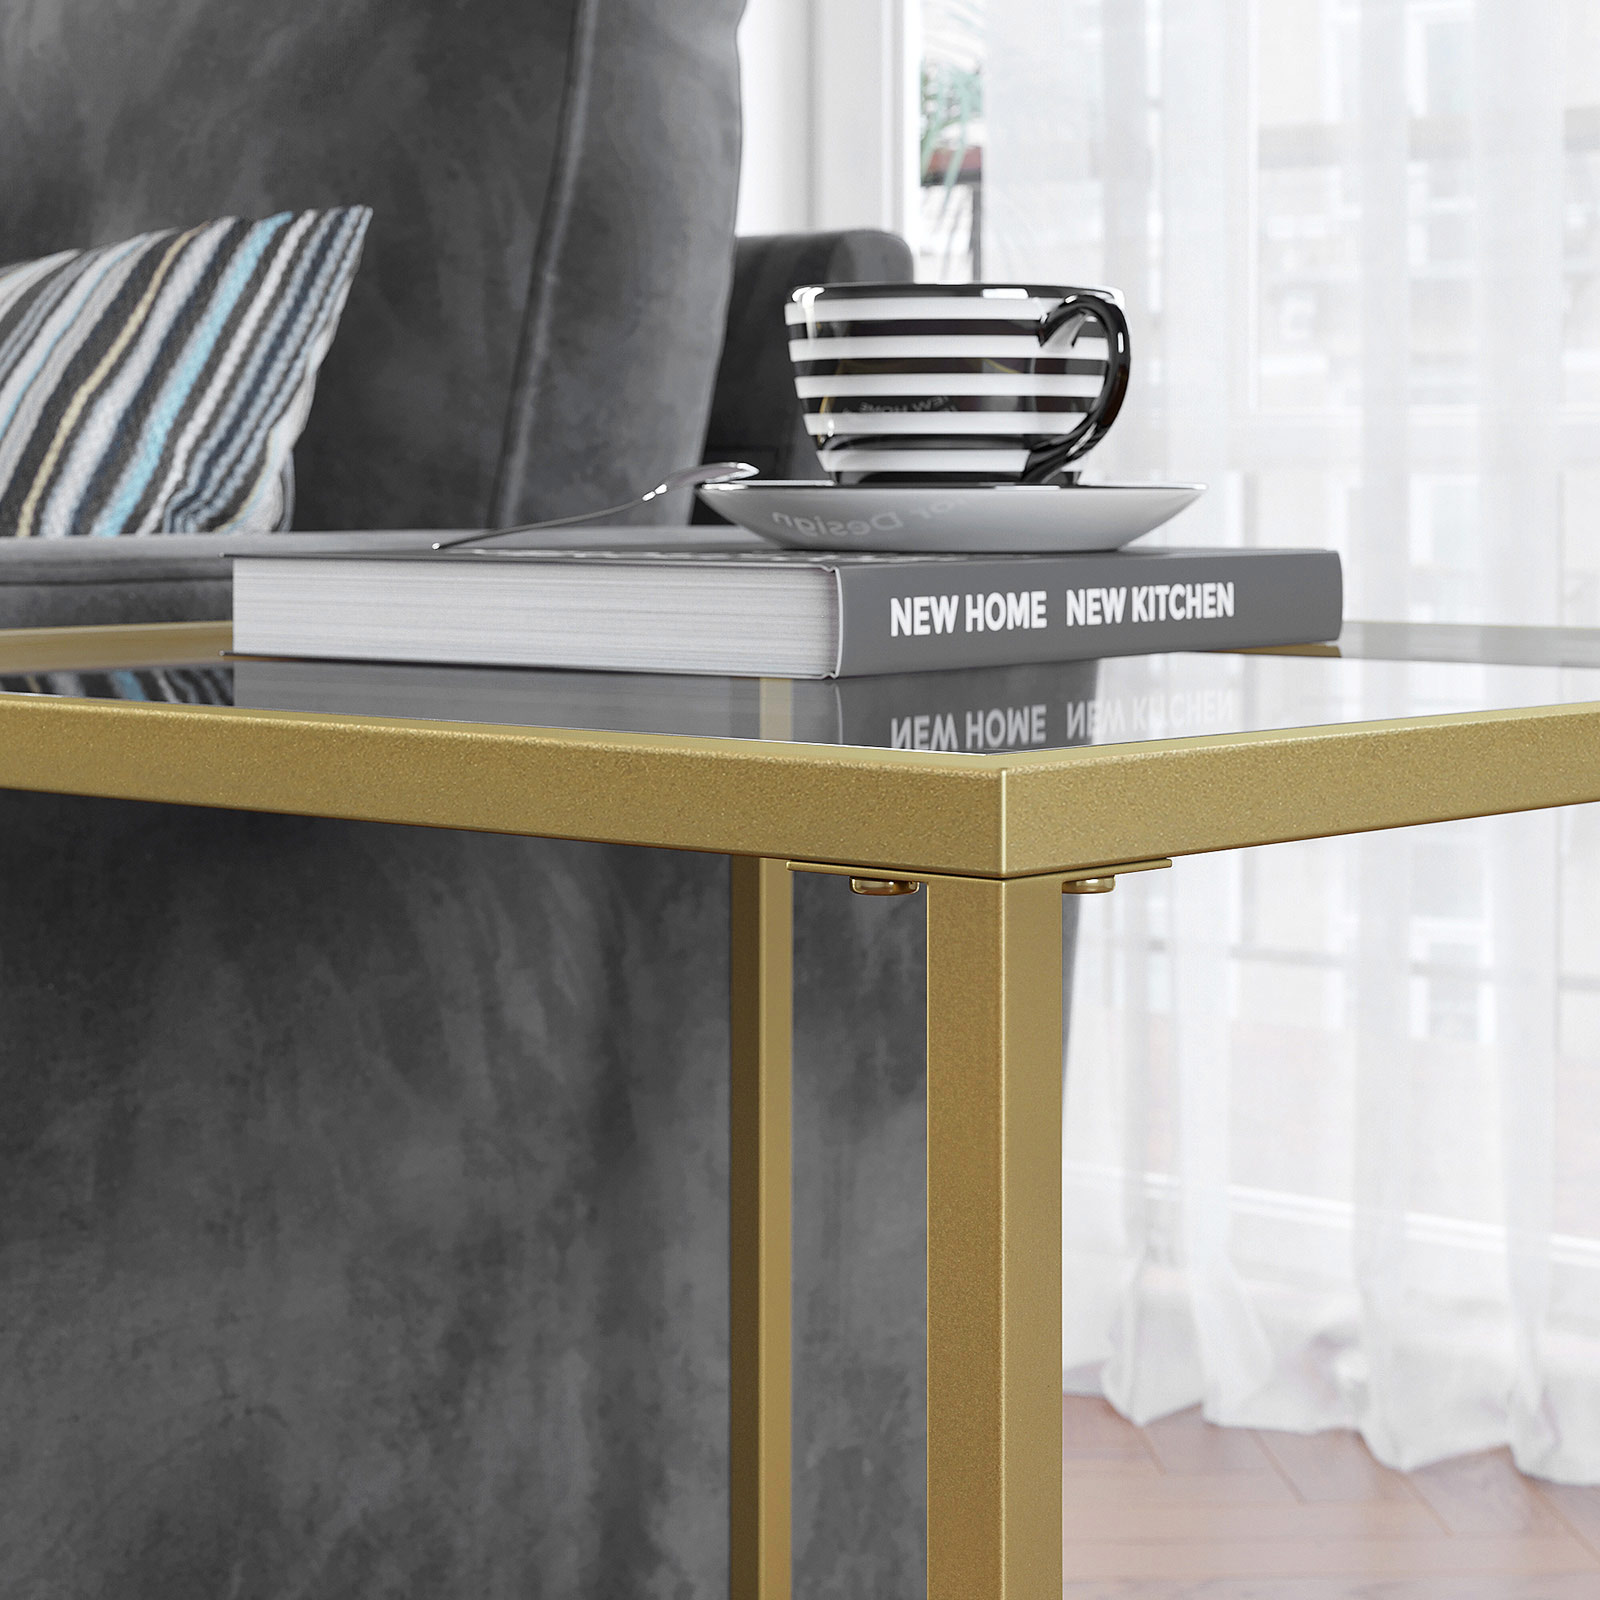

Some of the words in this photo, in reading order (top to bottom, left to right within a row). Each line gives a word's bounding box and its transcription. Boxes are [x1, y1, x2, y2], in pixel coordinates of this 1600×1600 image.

[890, 595, 959, 637] NEW
[965, 591, 1048, 633] HOME
[1066, 586, 1127, 627] NEW
[1131, 581, 1235, 623] KITCHEN
